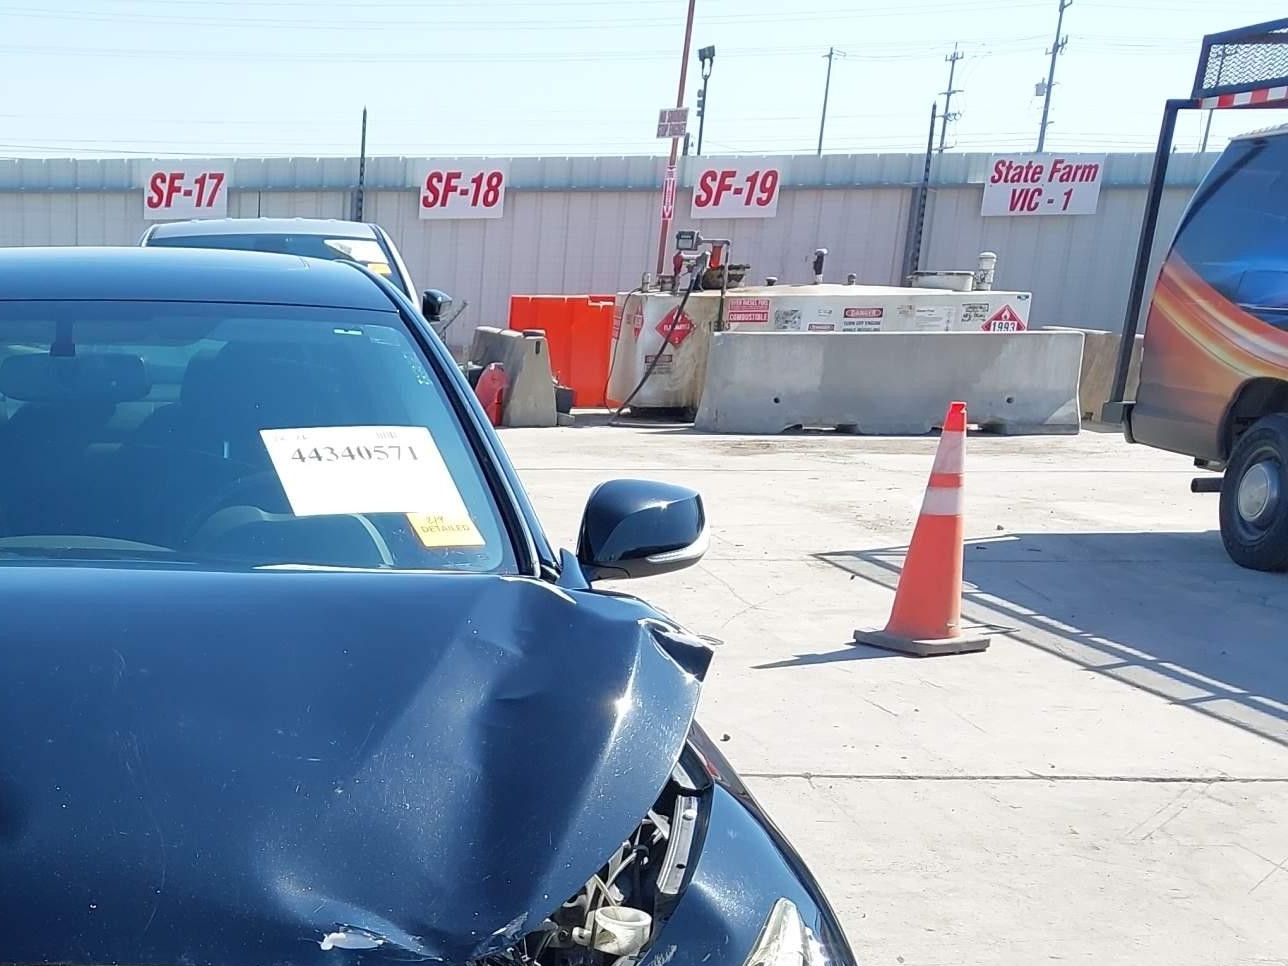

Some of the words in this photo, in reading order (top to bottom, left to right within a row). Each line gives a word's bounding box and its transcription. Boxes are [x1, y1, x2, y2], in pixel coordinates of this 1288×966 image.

[990, 159, 1044, 184] State
[1047, 159, 1100, 183] Farm
[146, 171, 224, 209] SF-17
[421, 170, 504, 209] SF-18
[694, 169, 779, 208] SF-19
[1009, 187, 1043, 212] VIC
[1062, 188, 1074, 212] 1
[730, 313, 768, 321] COMBUSTIBLE
[993, 321, 1016, 331] 1993
[291, 444, 418, 463] 44340571
[420, 524, 470, 533] DETAILED
